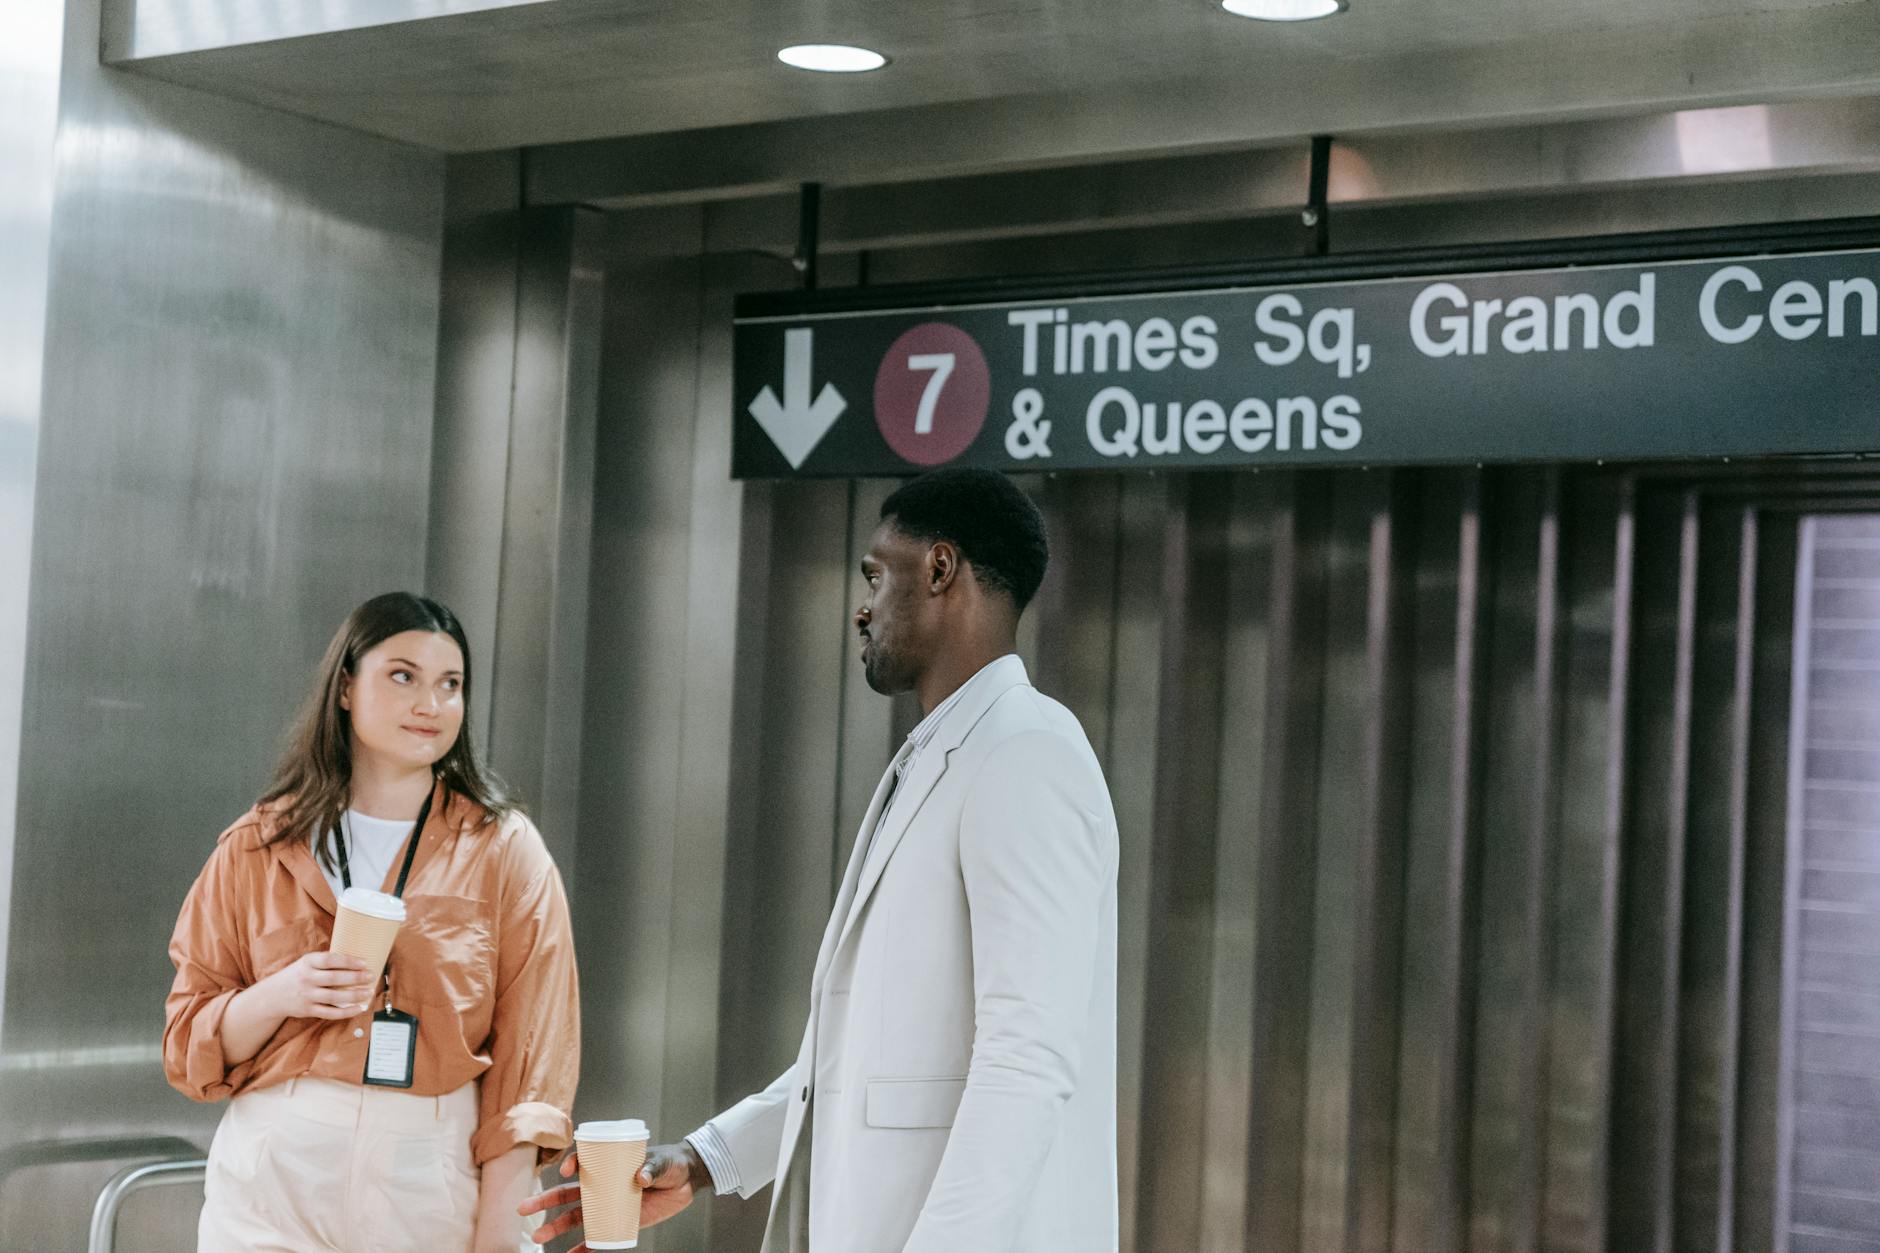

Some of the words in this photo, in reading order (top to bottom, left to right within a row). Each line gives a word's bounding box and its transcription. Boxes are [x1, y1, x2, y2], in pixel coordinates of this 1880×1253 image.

[1008, 308, 1219, 376] Times
[1254, 293, 1372, 379] Sq,
[1409, 272, 1656, 358] Grand
[1699, 265, 1878, 344] Cen
[908, 353, 956, 434] 7
[1004, 388, 1052, 460] &
[1086, 386, 1362, 458] Queens
